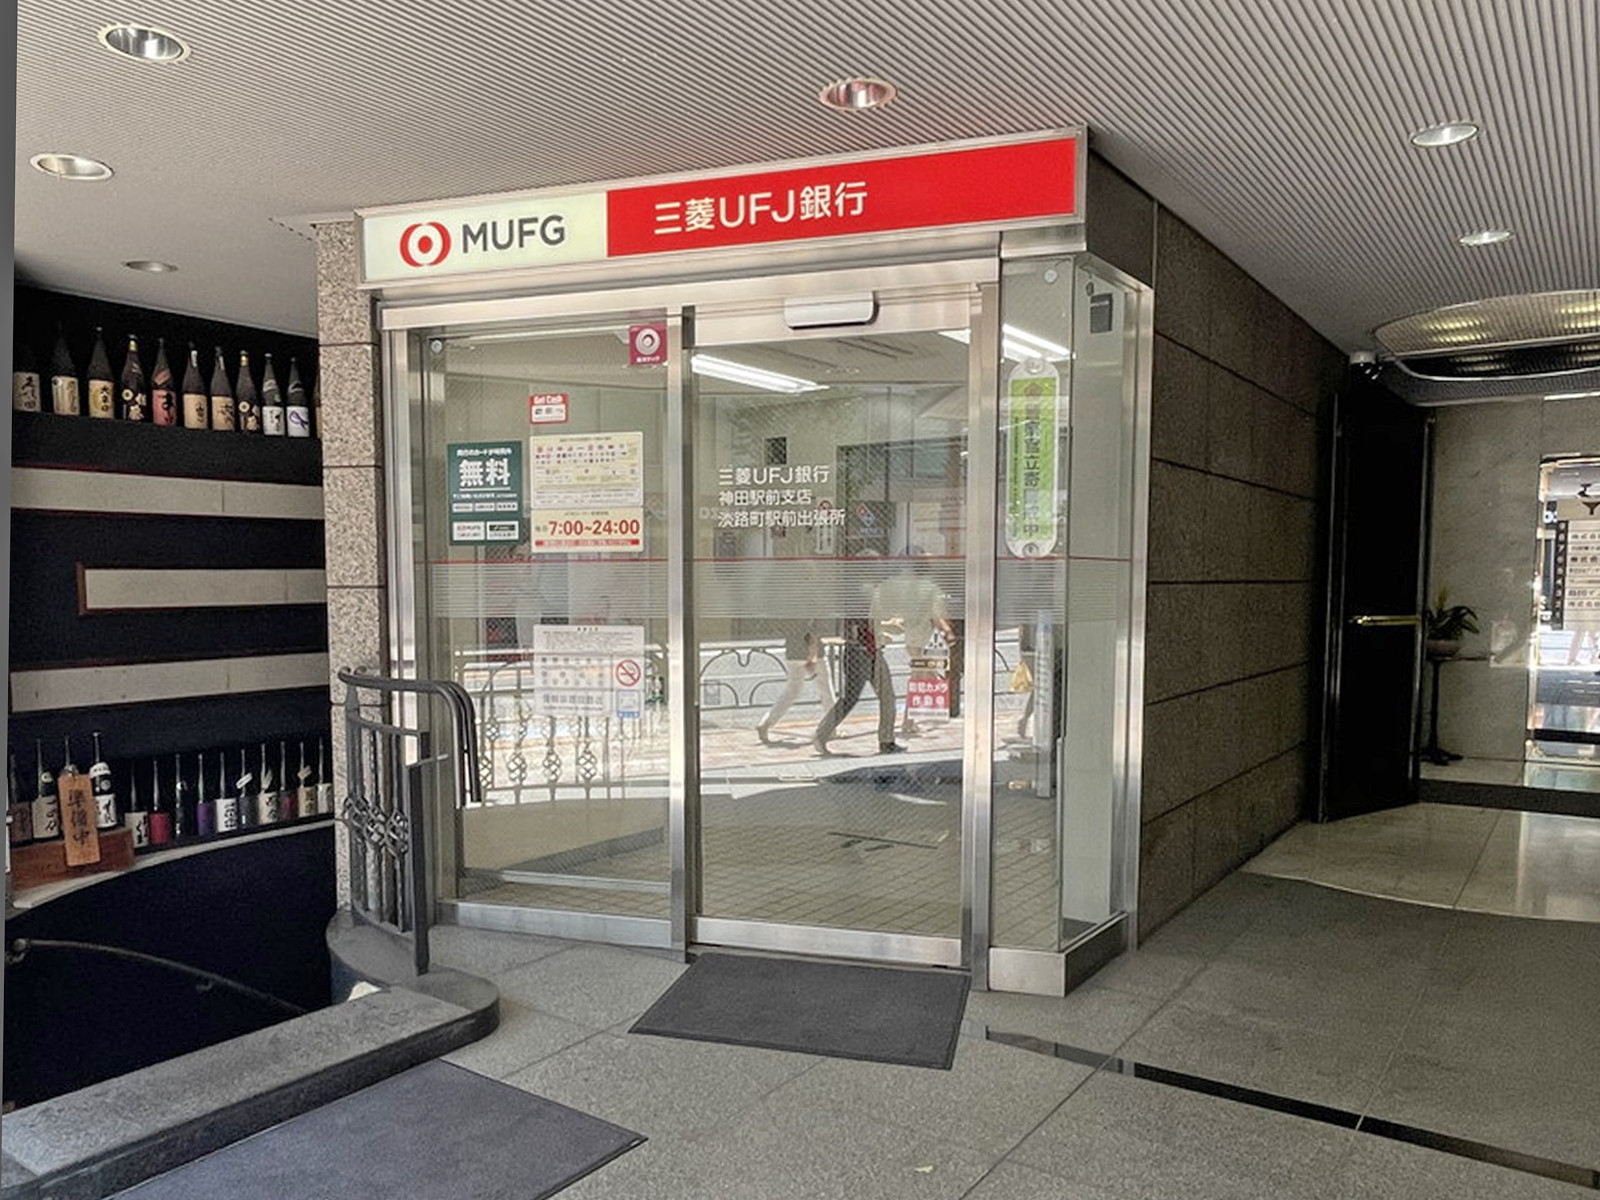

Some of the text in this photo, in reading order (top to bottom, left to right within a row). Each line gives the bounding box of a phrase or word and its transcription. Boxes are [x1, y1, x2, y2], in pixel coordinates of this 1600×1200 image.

[654, 181, 868, 234] 三菱UFJ銀行
[462, 214, 565, 254] MUFG
[459, 458, 511, 487] 無料
[719, 465, 830, 486] 三菱UFJ銀行
[718, 488, 813, 506] 神田駅前支店
[718, 508, 846, 528] 淡路町駅前出張所
